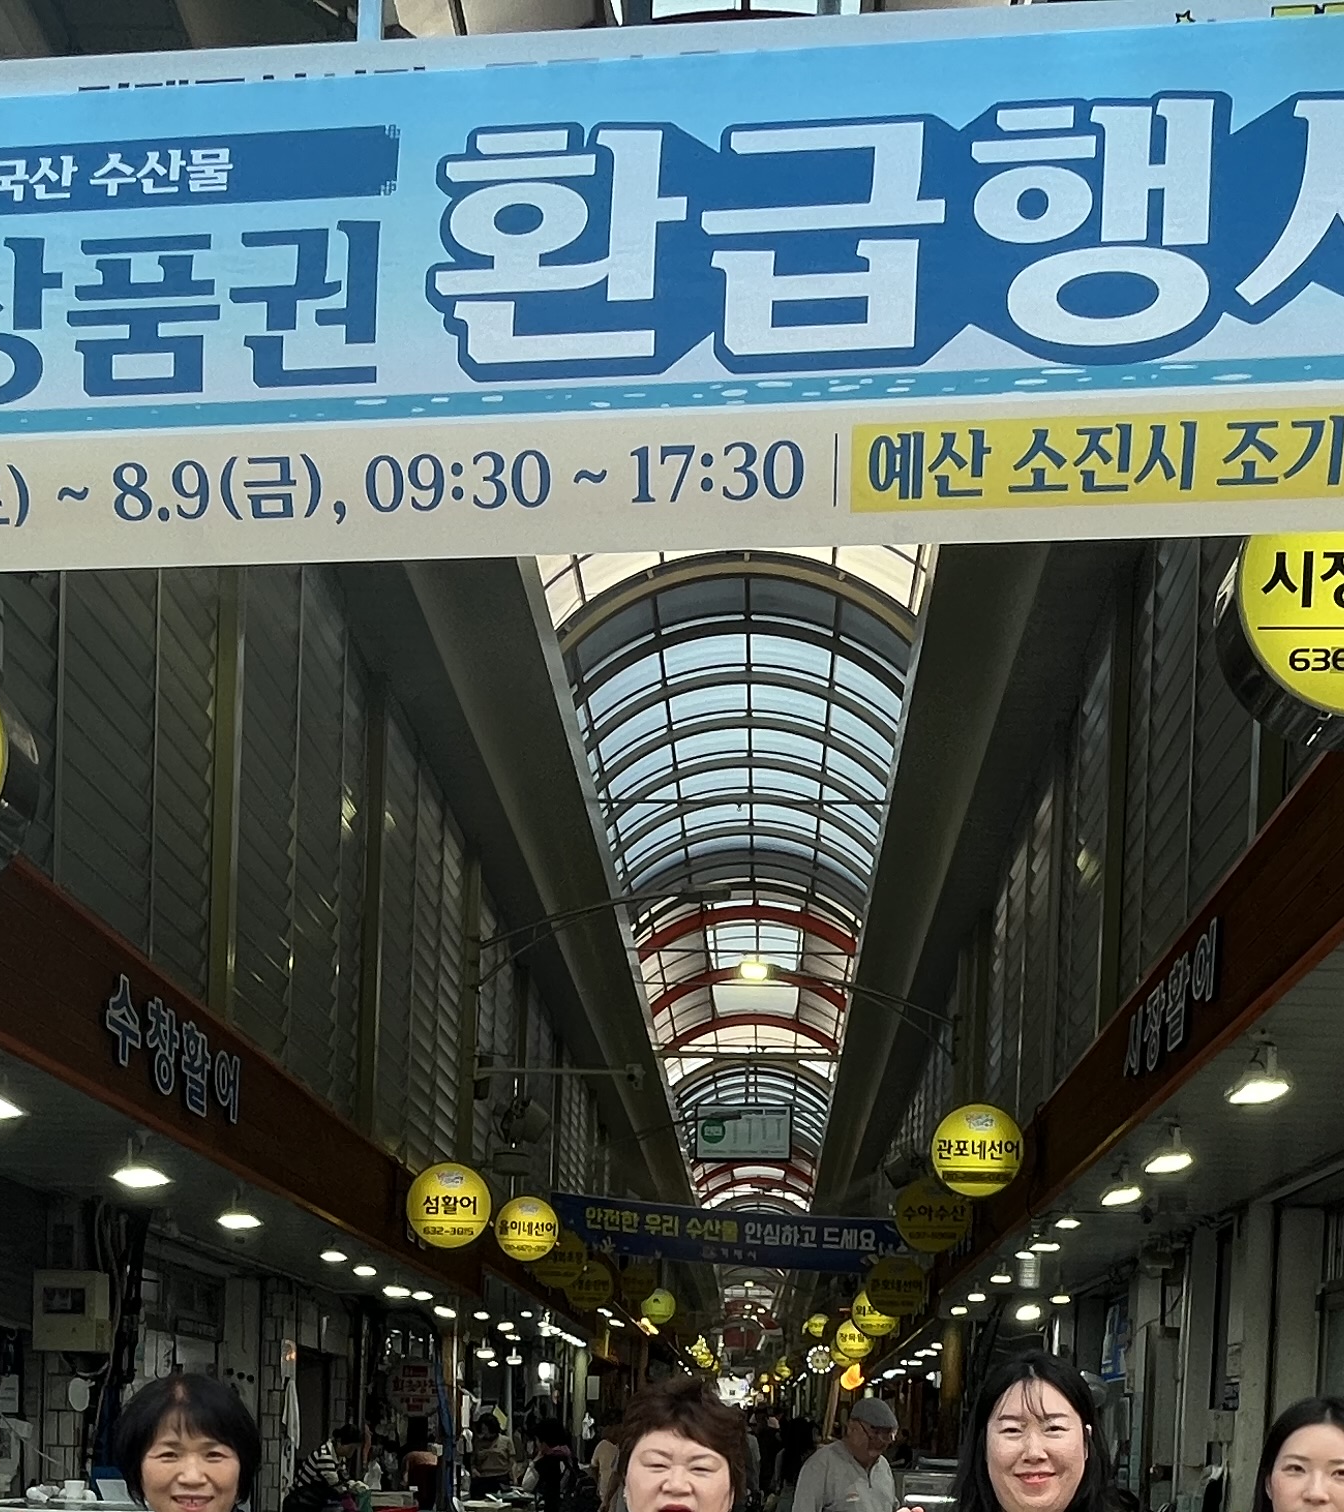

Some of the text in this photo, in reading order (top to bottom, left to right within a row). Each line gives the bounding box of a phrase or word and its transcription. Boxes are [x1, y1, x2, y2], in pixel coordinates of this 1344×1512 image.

[90, 146, 232, 197] 수산물
[114, 453, 347, 526] 8.9(금),
[365, 448, 551, 513] 09:30
[631, 439, 804, 505] 17:30
[870, 429, 990, 501] 예산
[1008, 420, 1195, 494] 소진시
[1123, 917, 1218, 1077] 시장활어
[107, 973, 241, 1125] 수창활어
[937, 1139, 1020, 1160] 관포네선어
[422, 1195, 477, 1216] 섬활어
[585, 1206, 640, 1234] 안전한
[644, 1214, 679, 1238] 우리
[744, 1221, 818, 1249] 안심하고
[822, 1227, 876, 1252] 드세요
